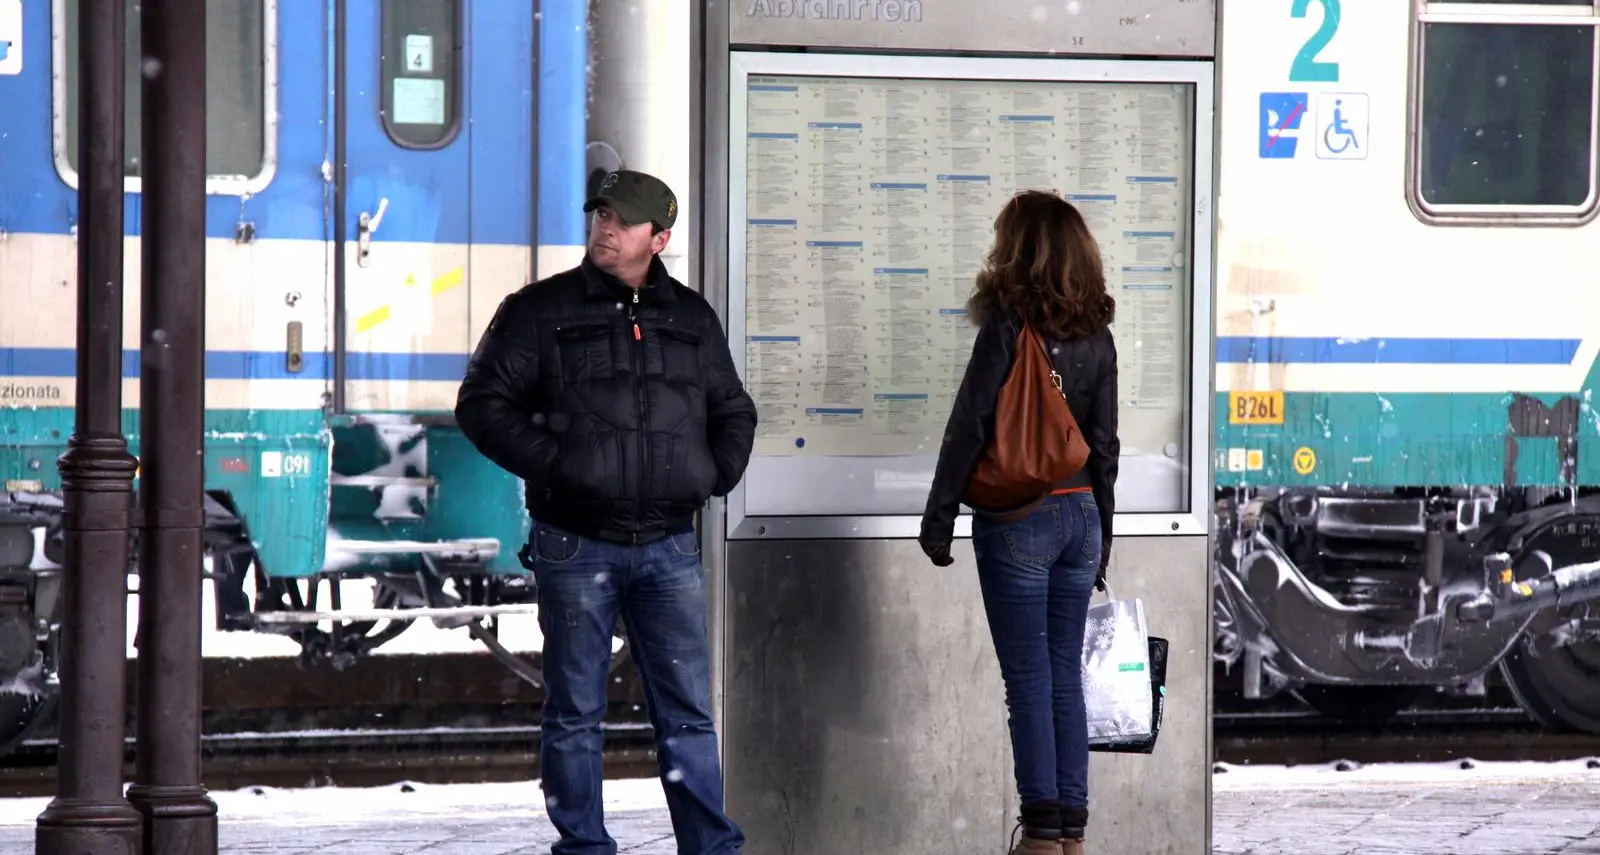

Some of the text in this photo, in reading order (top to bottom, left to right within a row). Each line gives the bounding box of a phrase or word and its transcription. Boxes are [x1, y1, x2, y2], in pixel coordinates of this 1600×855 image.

[1288, 0, 1341, 82] 2
[412, 53, 422, 68] 4
[2, 383, 60, 398] zionata
[1236, 396, 1277, 418] B26L
